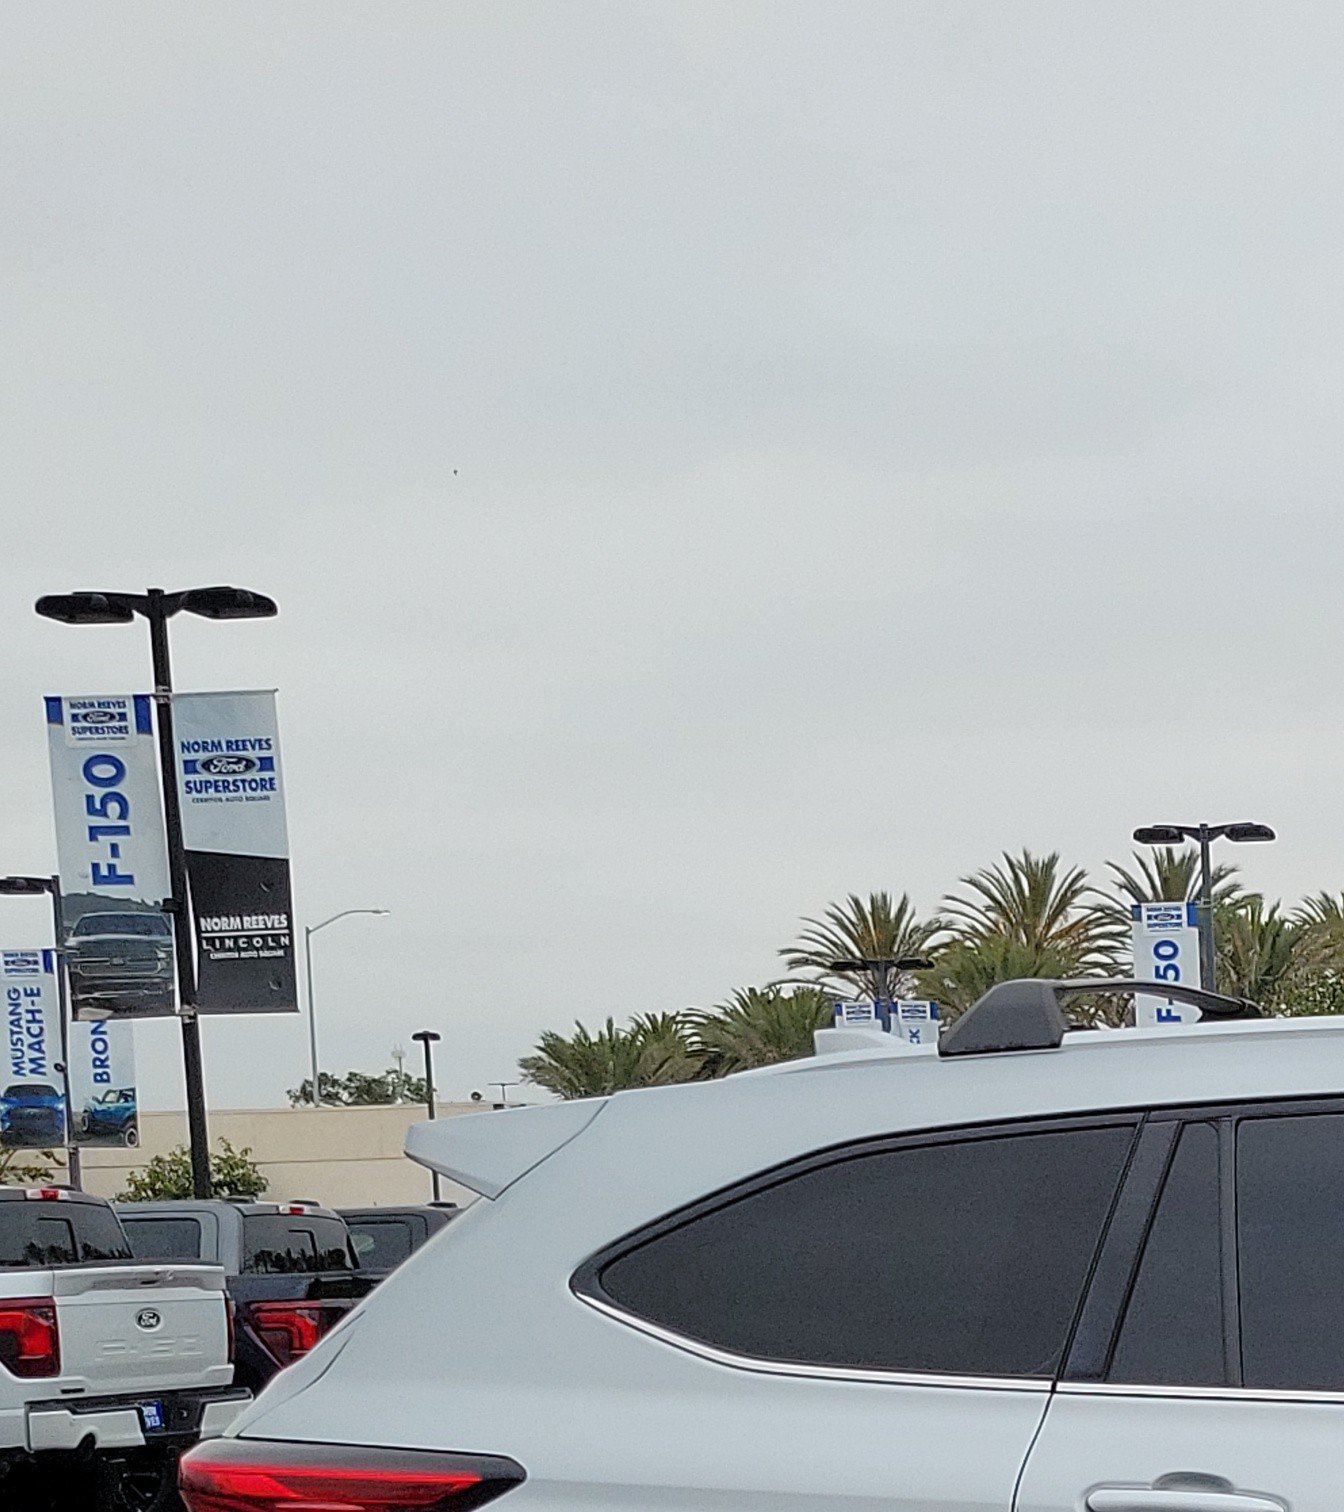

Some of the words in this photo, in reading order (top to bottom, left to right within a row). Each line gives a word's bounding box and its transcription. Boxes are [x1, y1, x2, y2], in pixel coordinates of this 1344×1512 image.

[181, 741, 224, 753] NORM
[225, 738, 272, 751] REEVES
[185, 778, 276, 794] SUPERSTORE
[82, 754, 135, 886] F-150
[200, 916, 242, 931] NORM
[243, 914, 288, 929] REEVES
[202, 935, 290, 950] LINCOLN
[1153, 940, 1182, 1023] F-50
[7, 987, 27, 1077] MUSTANG
[23, 986, 47, 1077] MACH-E
[90, 1020, 111, 1084] BRON
